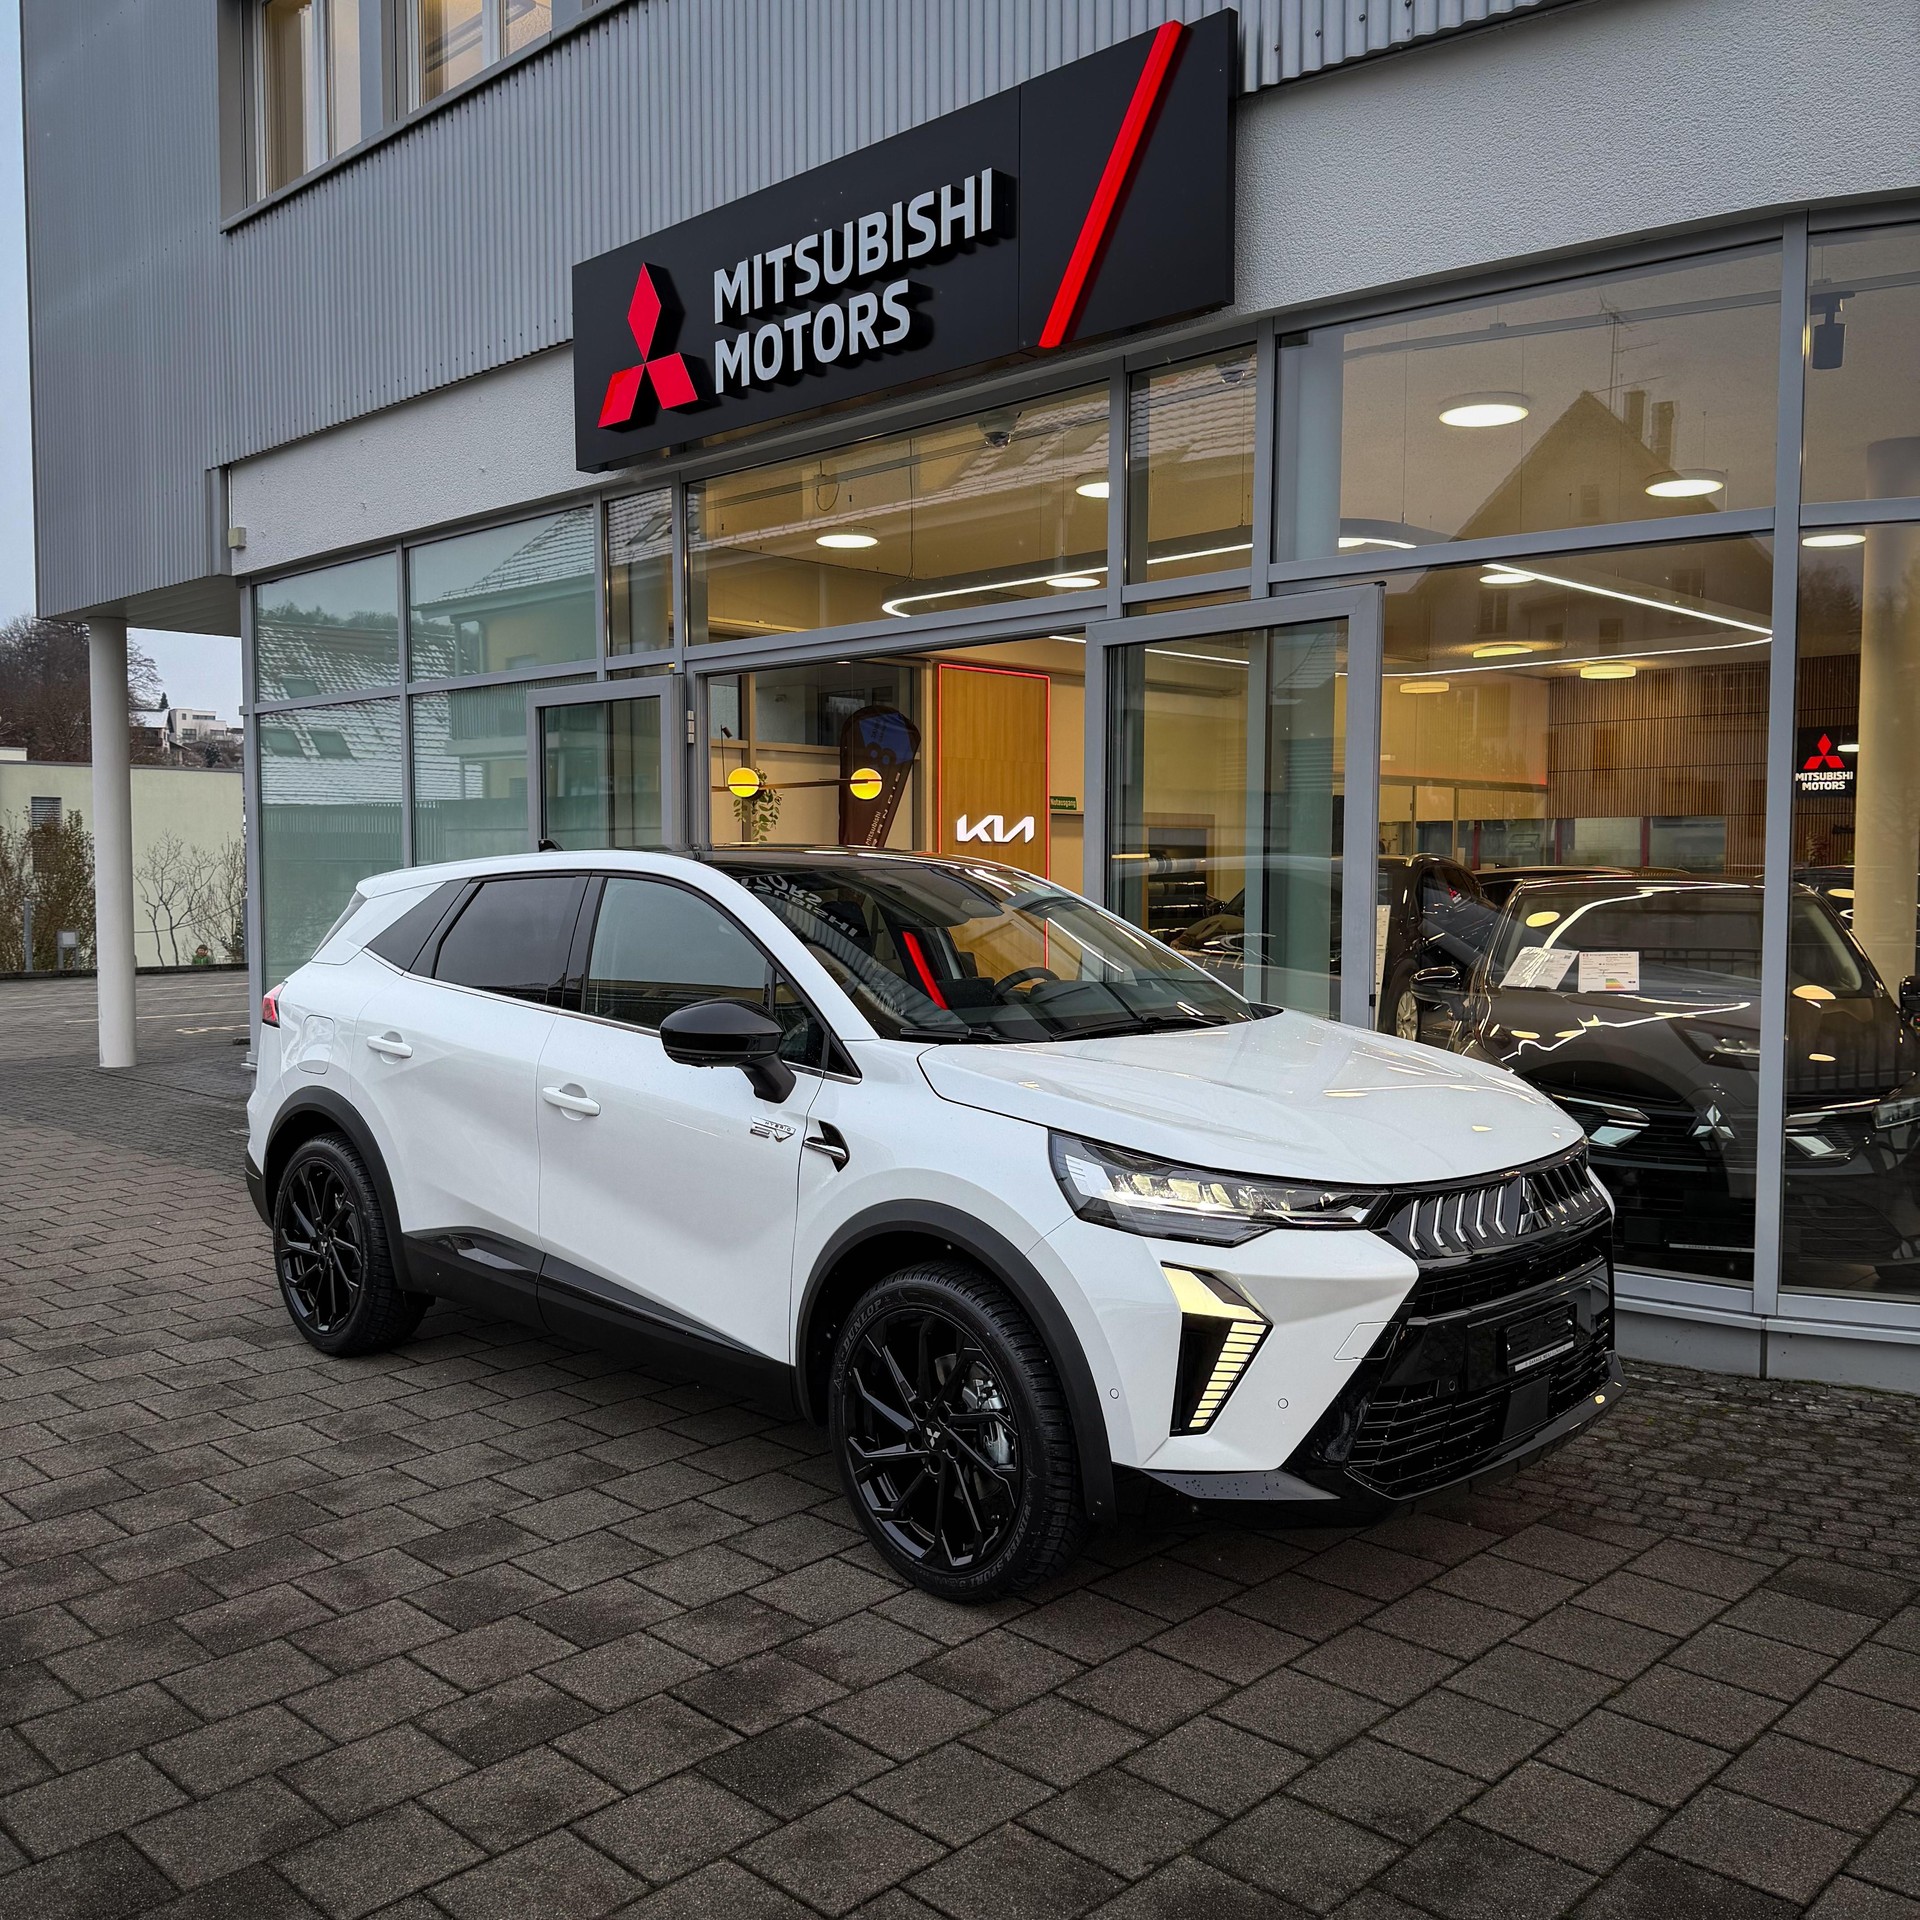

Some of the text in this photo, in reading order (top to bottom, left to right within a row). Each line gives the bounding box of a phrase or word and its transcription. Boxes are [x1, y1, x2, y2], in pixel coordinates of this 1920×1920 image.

[714, 167, 993, 324] MITSUBISHI
[714, 279, 911, 394] MOTORS
[1795, 771, 1854, 782] MITSUBISHI
[1802, 781, 1846, 791] MOTORS
[956, 814, 1035, 844] KIA
[842, 1299, 882, 1351] DUNLOP
[1004, 1504, 1032, 1562] WINTER
[970, 1559, 1005, 1588] SPORT
